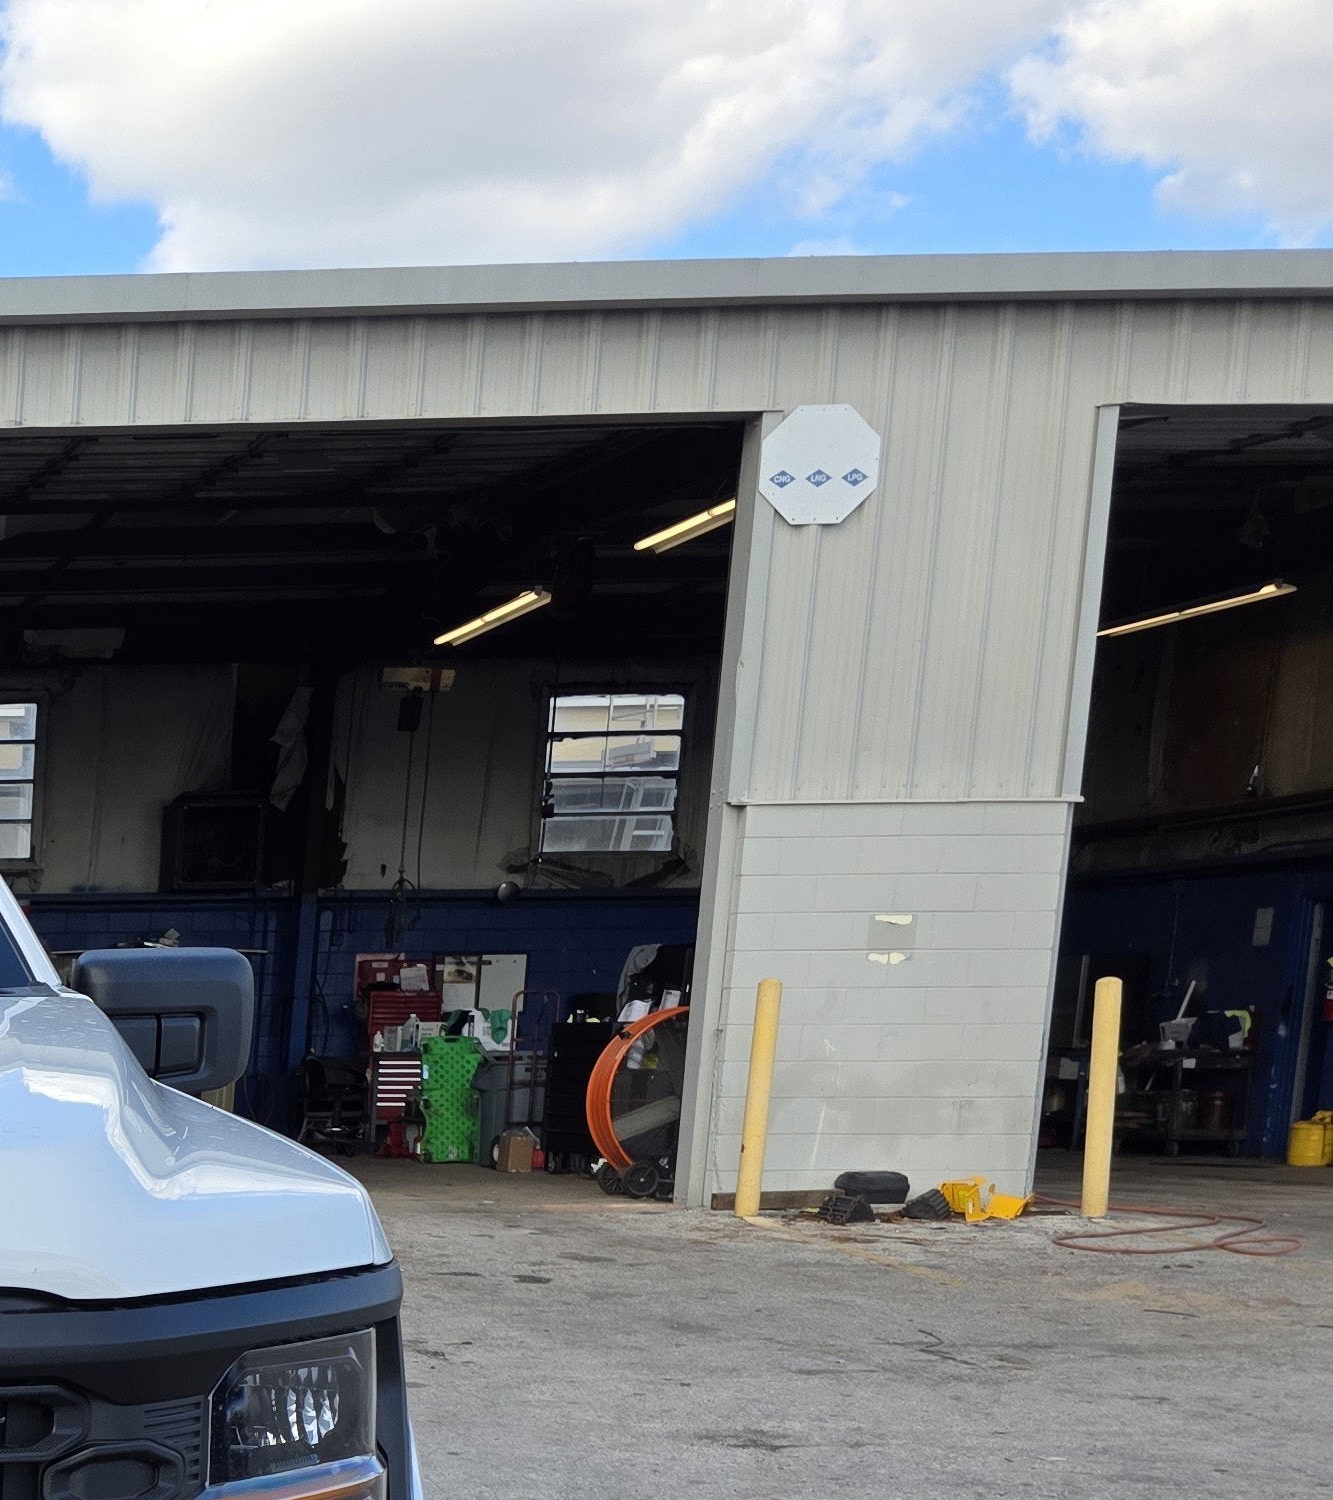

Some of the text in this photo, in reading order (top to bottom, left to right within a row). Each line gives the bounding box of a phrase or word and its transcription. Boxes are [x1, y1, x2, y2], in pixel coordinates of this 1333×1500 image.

[773, 473, 863, 483] CNG LNG LPG
